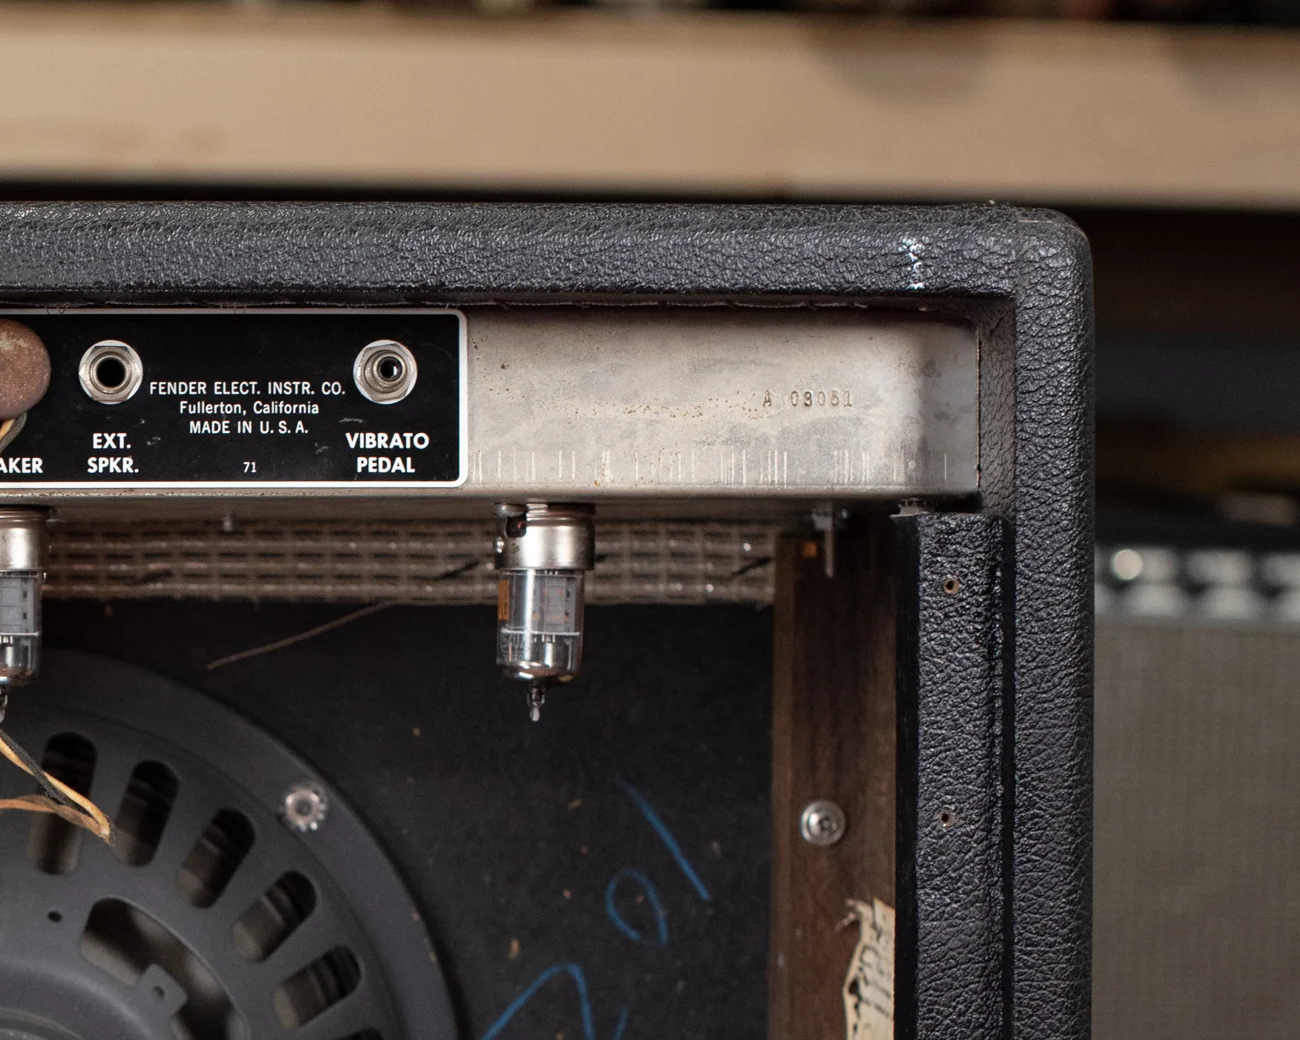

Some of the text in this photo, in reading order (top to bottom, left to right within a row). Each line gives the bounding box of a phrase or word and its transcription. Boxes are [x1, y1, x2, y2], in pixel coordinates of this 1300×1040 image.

[149, 381, 346, 395] FENDER ELECT. INSTR. CO.
[179, 400, 320, 416] Fullerton, California
[189, 420, 231, 434] MADE
[237, 420, 253, 434] IN
[92, 432, 132, 450] EXT.
[345, 432, 430, 450] VIBRATO
[86, 456, 140, 474] SPKR.
[242, 461, 258, 473] 71
[356, 456, 416, 474] PEDAL
